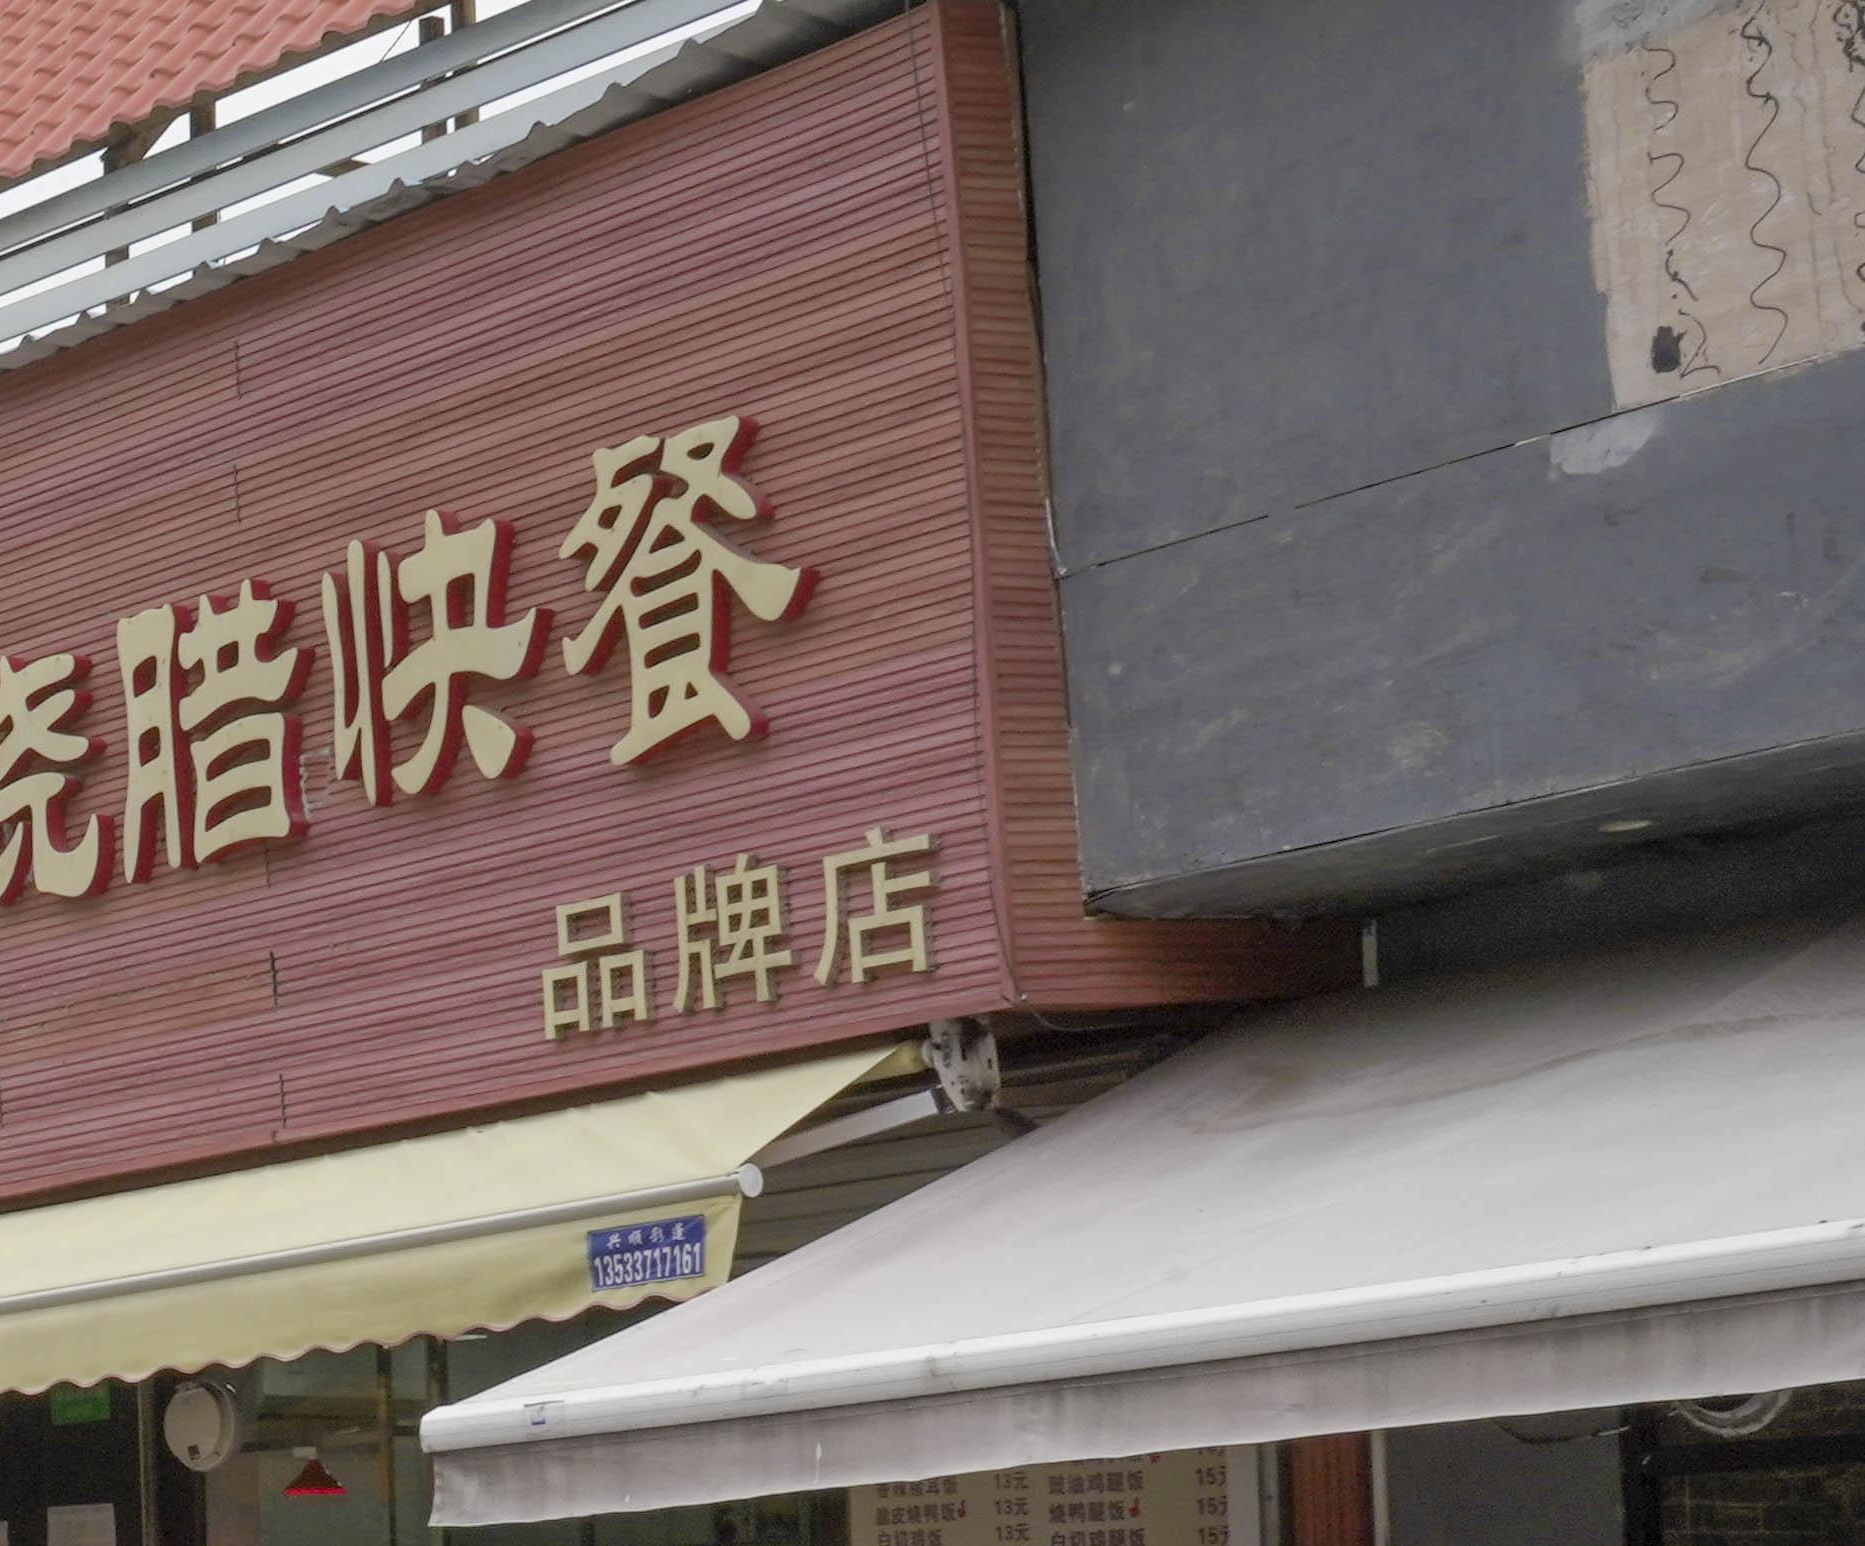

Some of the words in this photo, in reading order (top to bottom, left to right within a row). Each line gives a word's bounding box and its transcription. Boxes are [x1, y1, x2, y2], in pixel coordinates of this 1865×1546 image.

[541, 827, 938, 1041] 品牌店
[594, 1243, 701, 1286] 13533717161
[994, 1472, 1028, 1490] 13元
[995, 1499, 1029, 1517] 13元
[995, 1525, 1030, 1543] 13元
